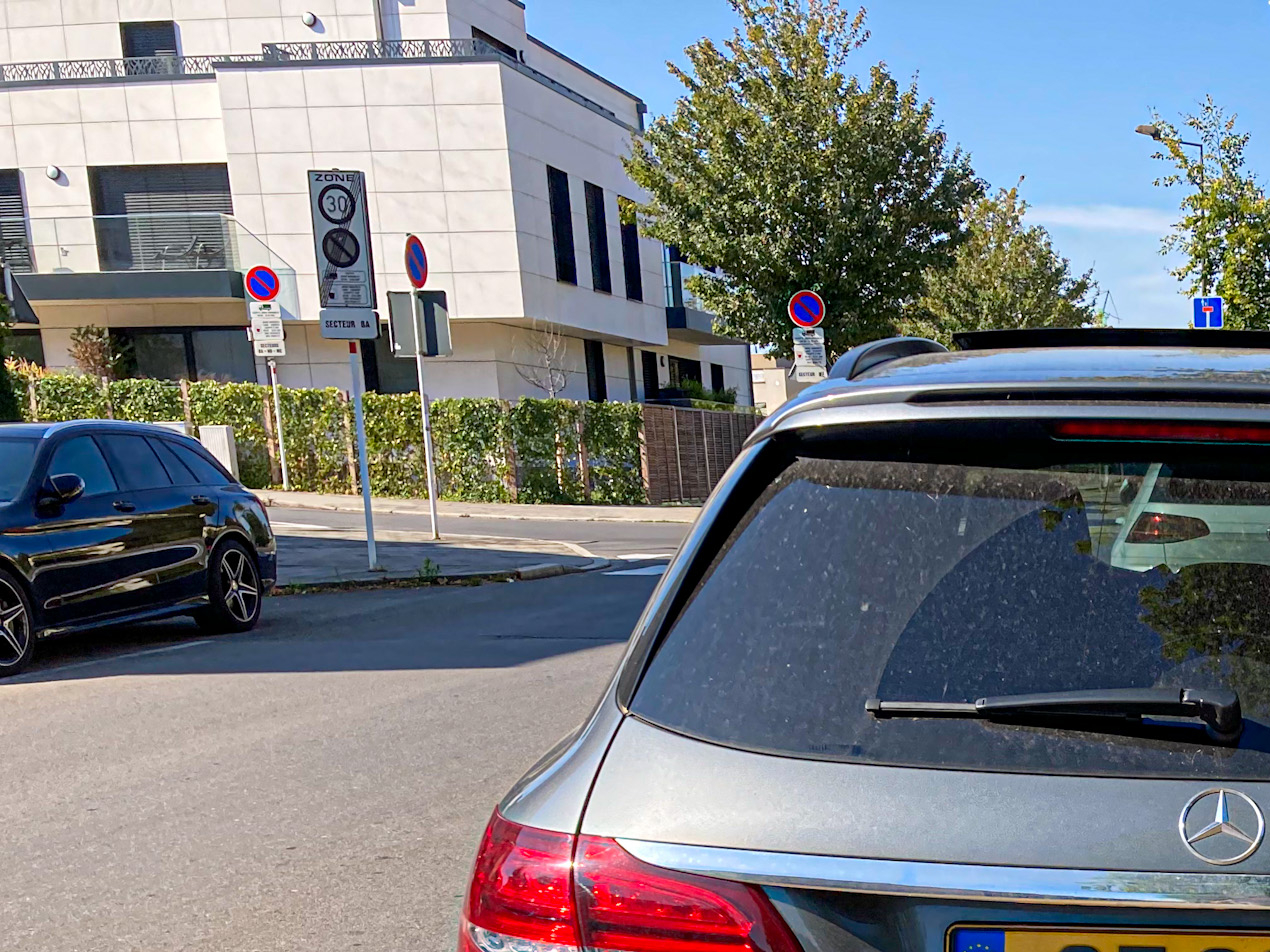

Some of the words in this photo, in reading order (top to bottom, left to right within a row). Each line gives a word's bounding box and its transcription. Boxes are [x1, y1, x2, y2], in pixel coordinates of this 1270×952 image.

[314, 173, 355, 182] ZONE
[326, 195, 348, 213] 30
[325, 320, 356, 328] SECTEUR
